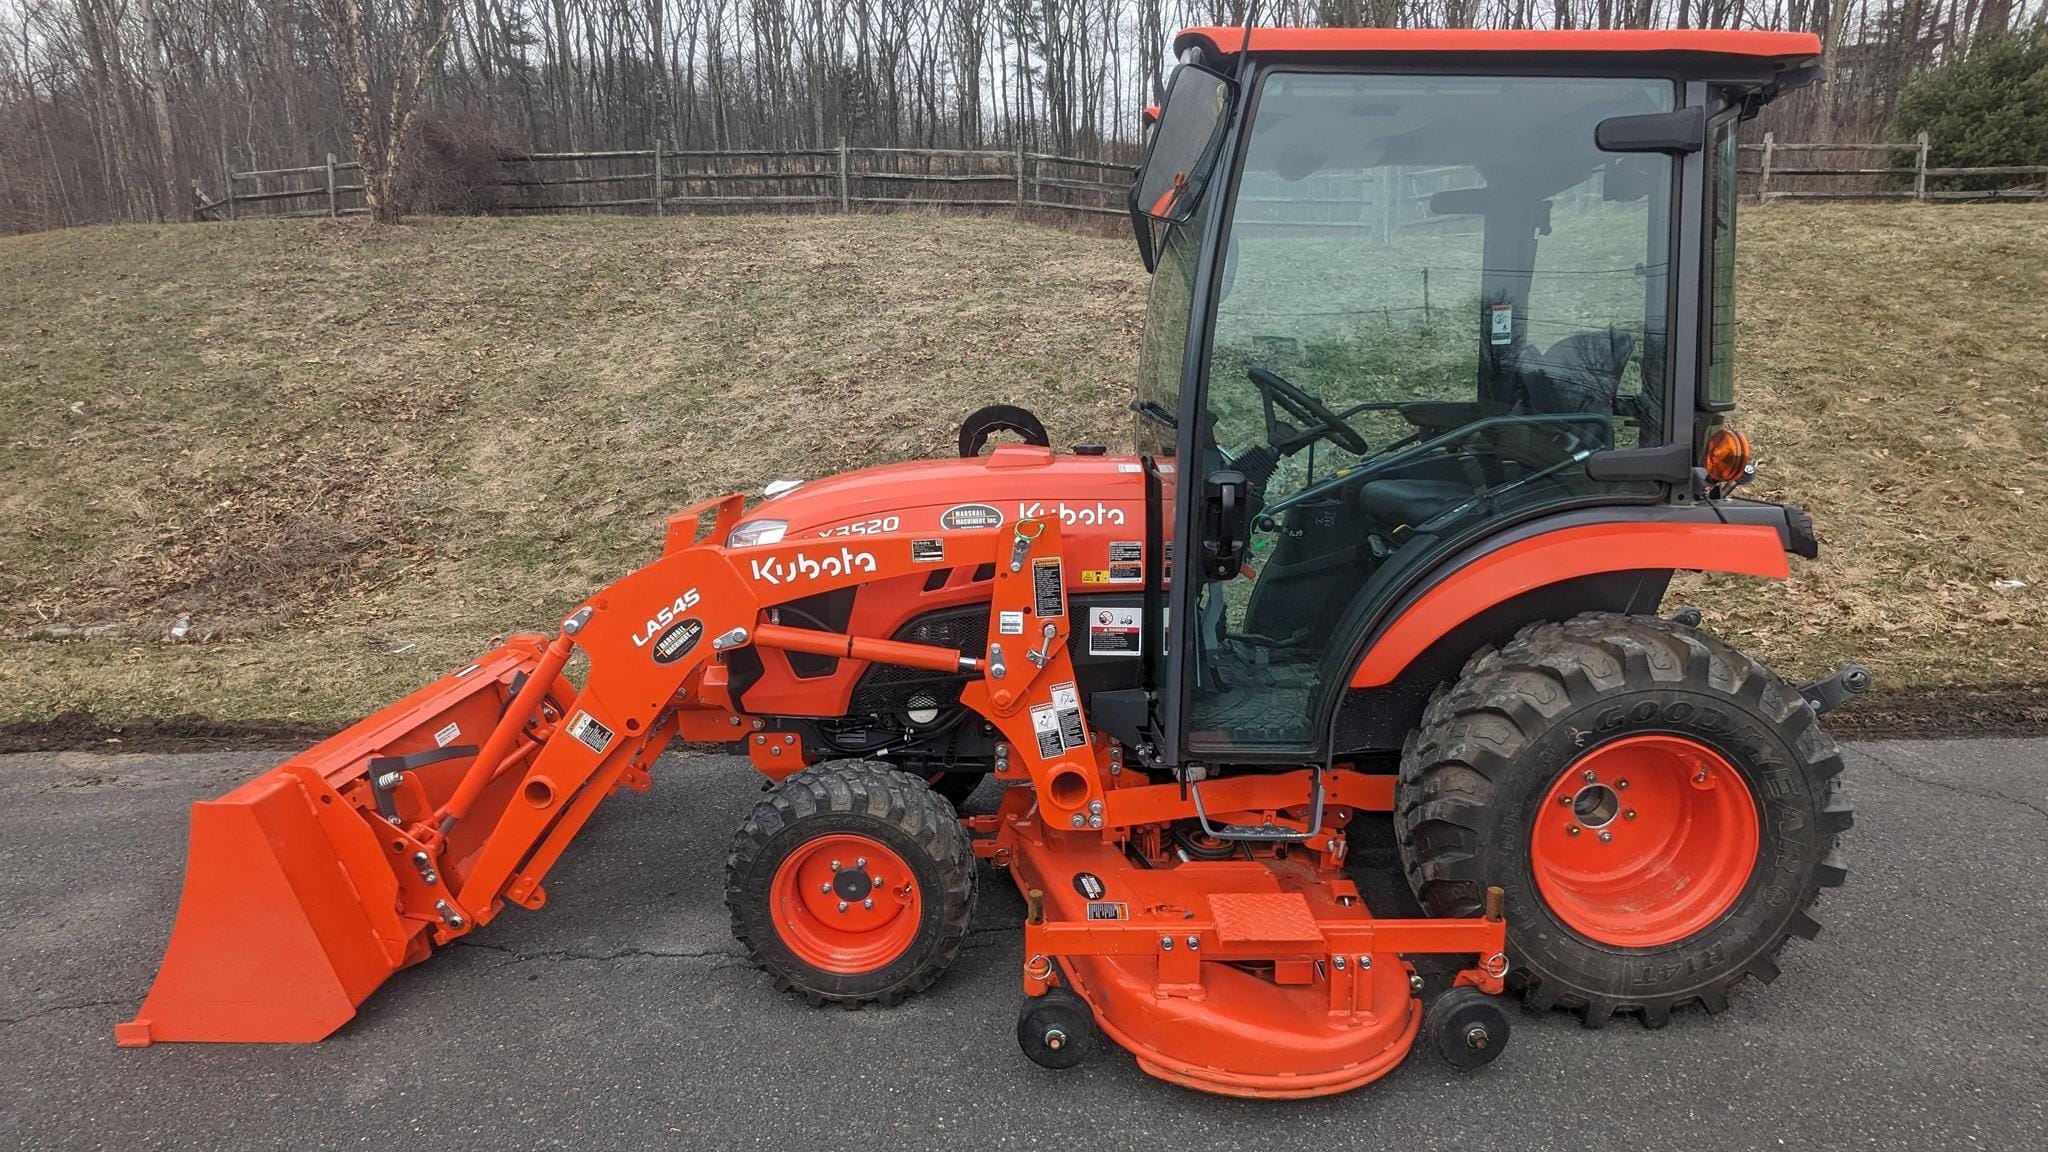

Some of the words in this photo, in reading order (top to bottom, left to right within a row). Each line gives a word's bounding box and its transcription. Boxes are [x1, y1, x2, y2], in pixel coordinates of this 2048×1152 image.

[955, 509, 986, 517] MARSHALL
[750, 547, 877, 585] Kubota
[631, 587, 701, 647] LA545
[658, 625, 686, 650] MARSHALL
